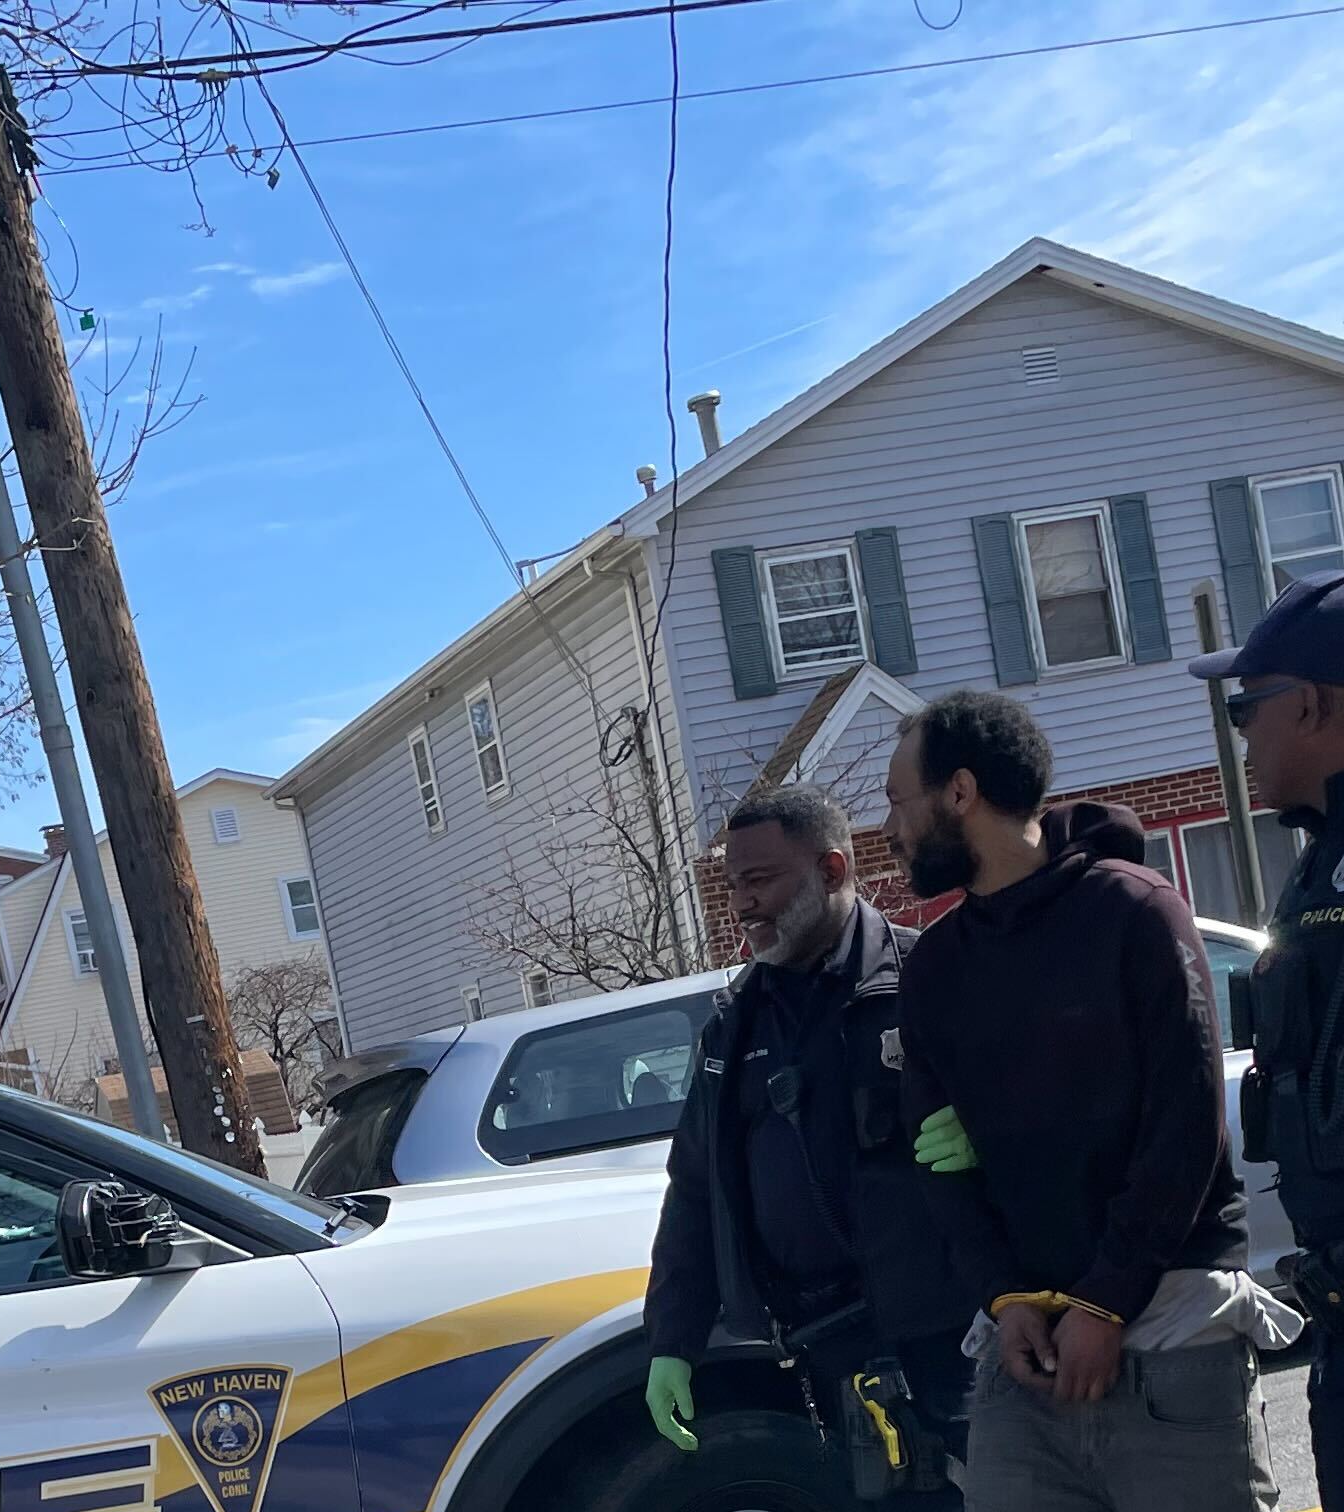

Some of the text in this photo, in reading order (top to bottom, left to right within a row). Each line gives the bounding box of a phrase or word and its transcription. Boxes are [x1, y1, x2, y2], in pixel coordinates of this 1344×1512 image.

[159, 1374, 281, 1408] NEW HAVEN
[218, 1467, 251, 1483] POLICE
[221, 1483, 251, 1498] CONN.
